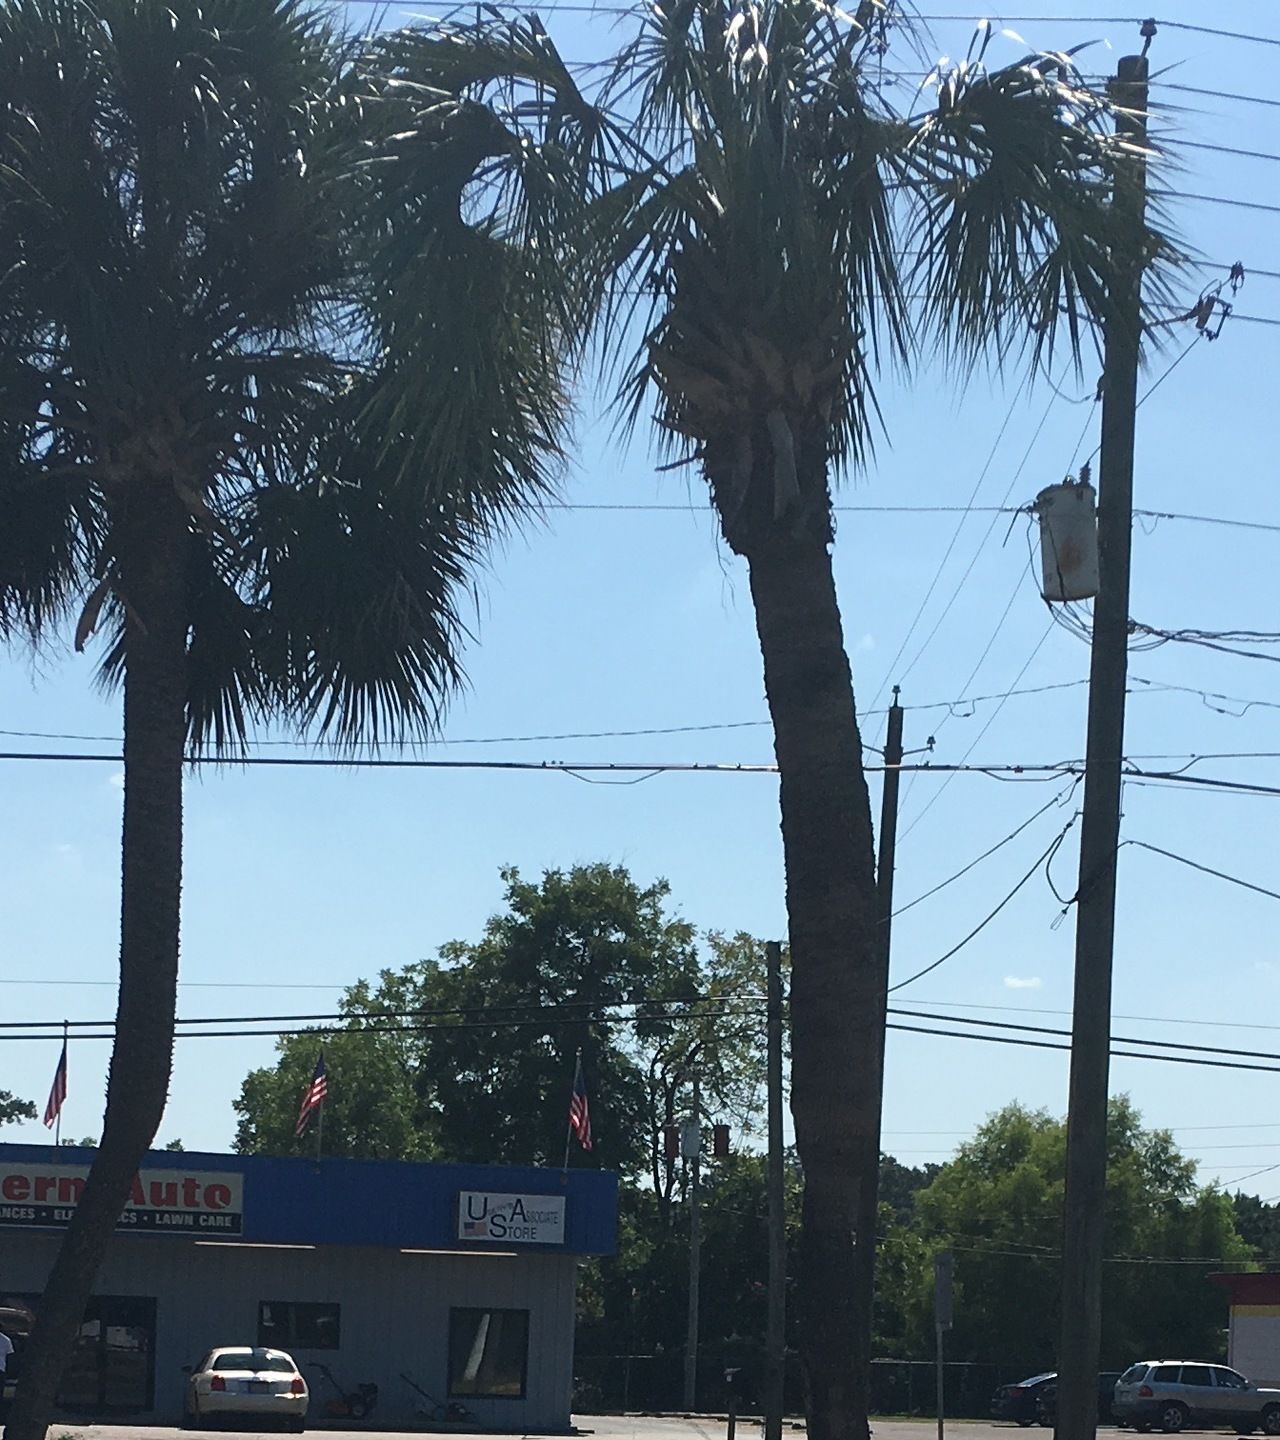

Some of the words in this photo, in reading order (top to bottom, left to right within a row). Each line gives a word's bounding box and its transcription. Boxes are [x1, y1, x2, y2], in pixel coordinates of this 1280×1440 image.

[127, 1170, 231, 1210] Auto
[155, 1212, 194, 1227] LAWN
[199, 1215, 232, 1228] CARE
[489, 1213, 537, 1240] STORE
